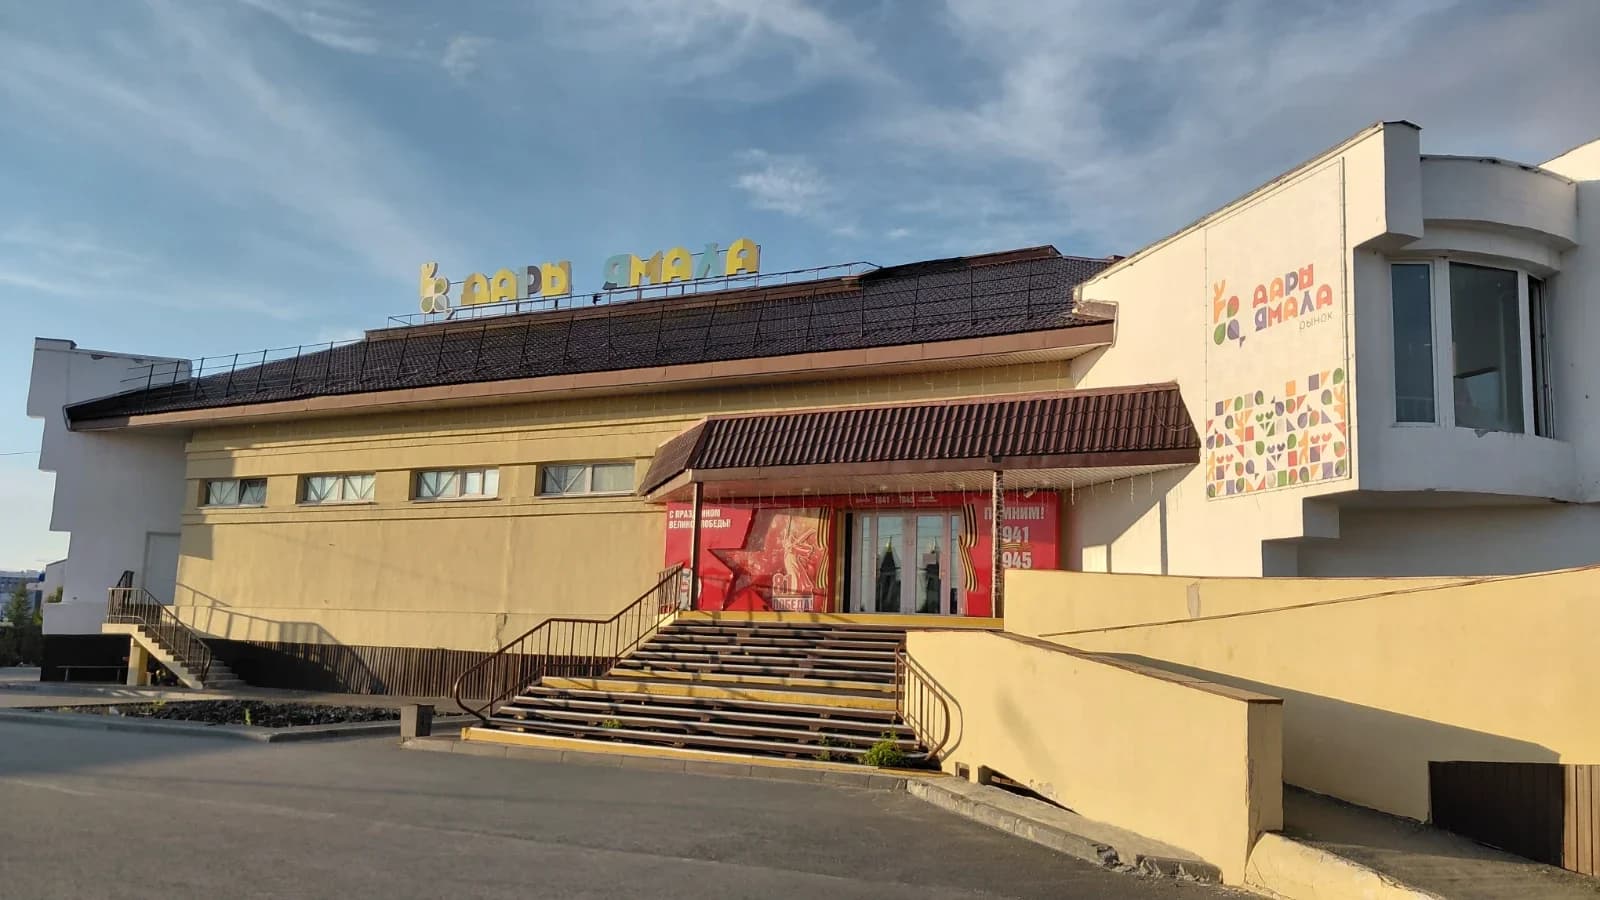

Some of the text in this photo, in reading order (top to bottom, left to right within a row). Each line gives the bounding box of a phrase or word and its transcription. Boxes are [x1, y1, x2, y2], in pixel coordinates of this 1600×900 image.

[461, 238, 761, 306] ДАРЫ ЯМАЛА
[1252, 263, 1314, 308] ДАРЫ
[1255, 283, 1333, 331] ЯМАЛА
[668, 520, 698, 529] ВЕЛИКО
[675, 508, 721, 518] ПРАЗИКОМ
[983, 506, 1045, 520] ПМНИМ!
